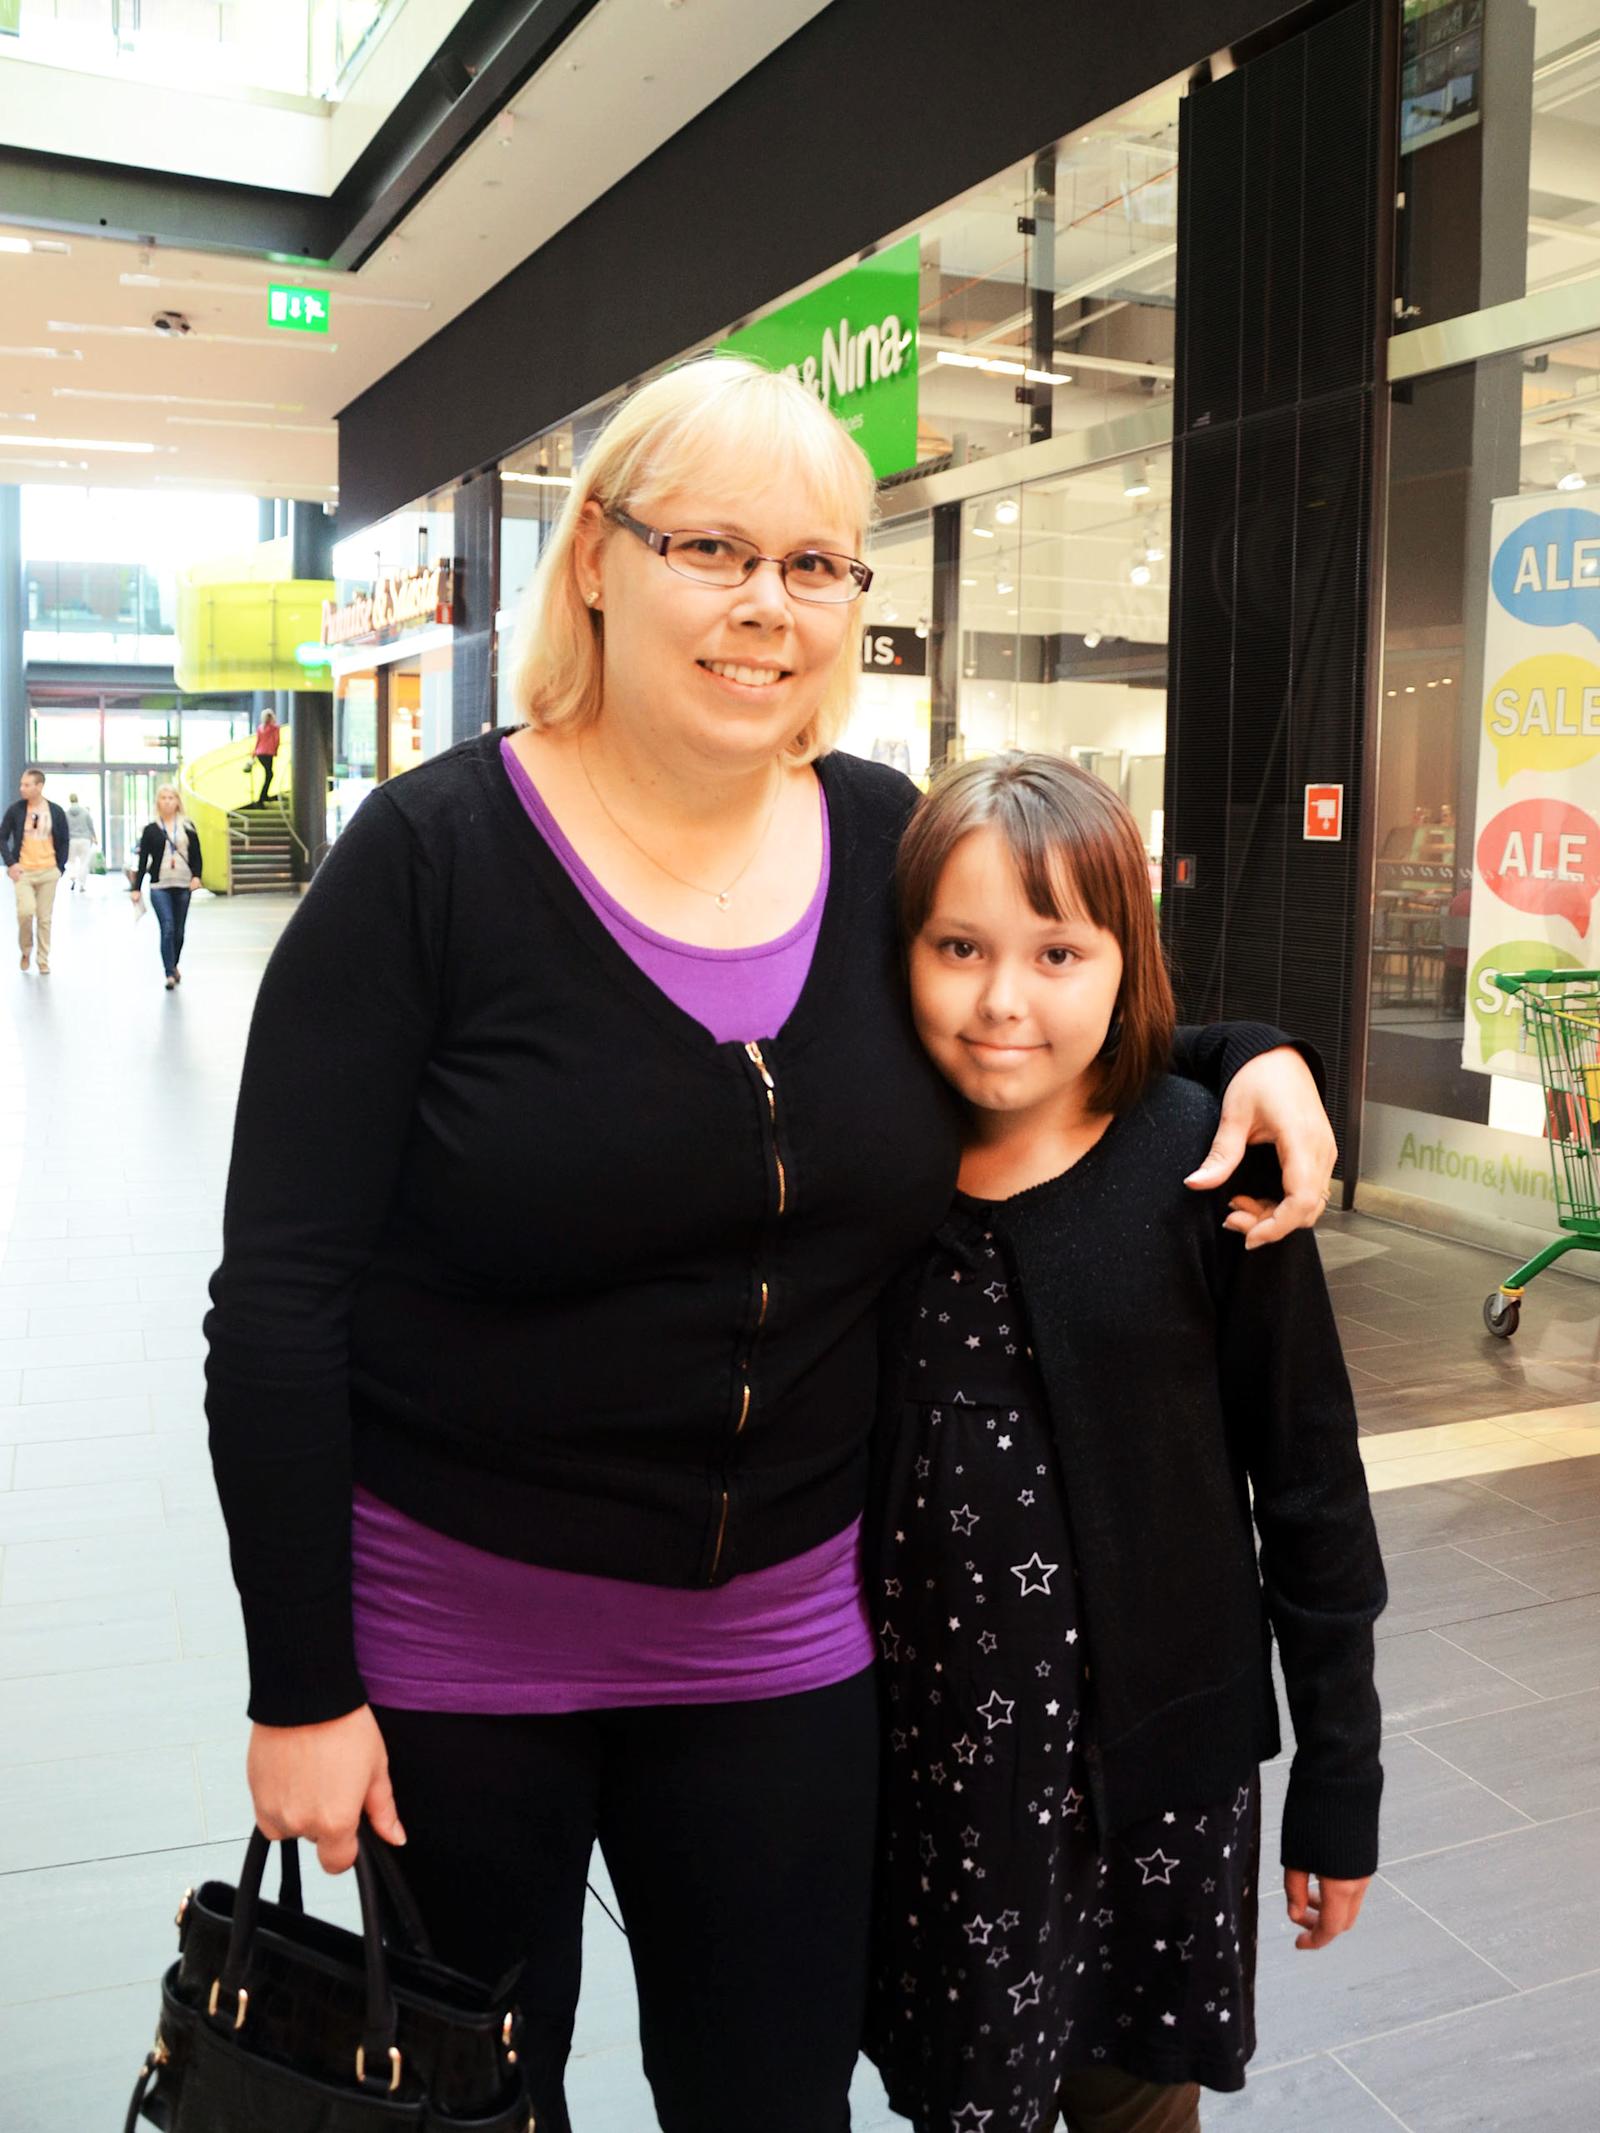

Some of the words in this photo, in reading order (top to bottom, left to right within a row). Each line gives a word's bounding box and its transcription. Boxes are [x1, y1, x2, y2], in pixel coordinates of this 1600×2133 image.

[1513, 539, 1600, 594] ALE
[1490, 687, 1600, 737] SALE
[1498, 831, 1587, 883] ALE
